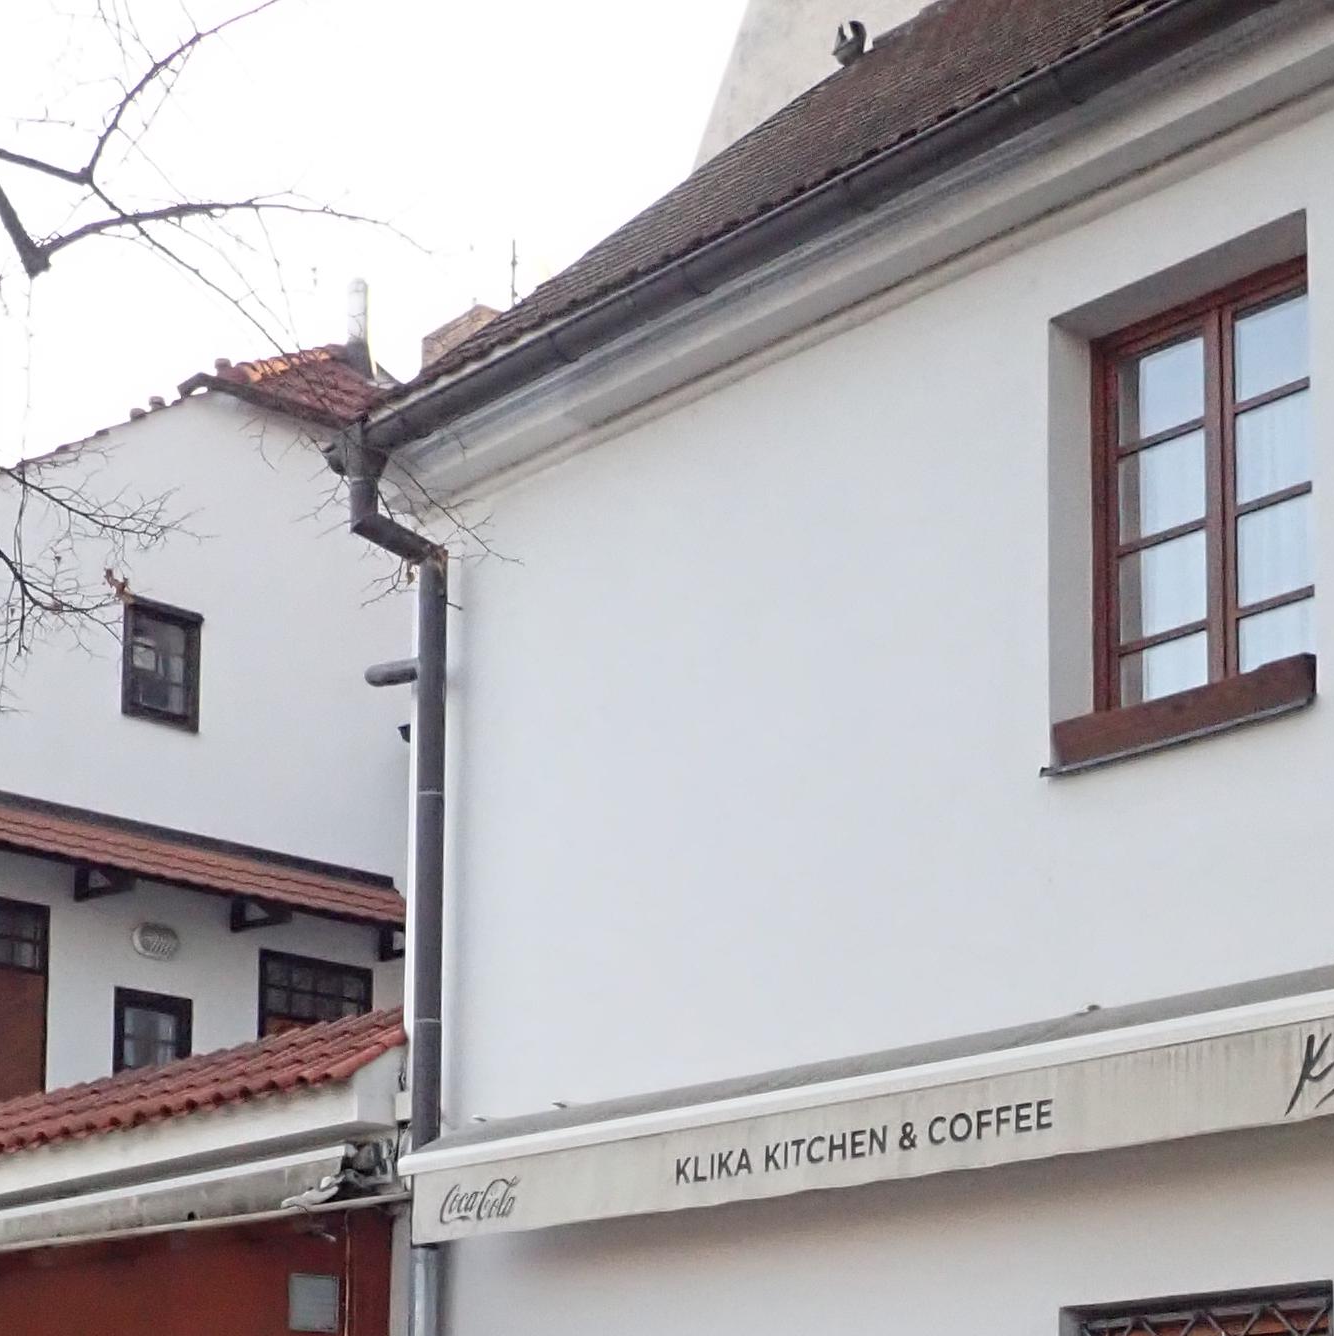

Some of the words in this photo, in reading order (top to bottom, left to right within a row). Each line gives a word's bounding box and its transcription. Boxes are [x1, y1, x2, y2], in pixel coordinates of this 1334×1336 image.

[675, 1148, 753, 1185] KLIKA
[765, 1124, 888, 1172] KITCHEN
[898, 1122, 918, 1150] &
[928, 1099, 1054, 1146] COFFEE
